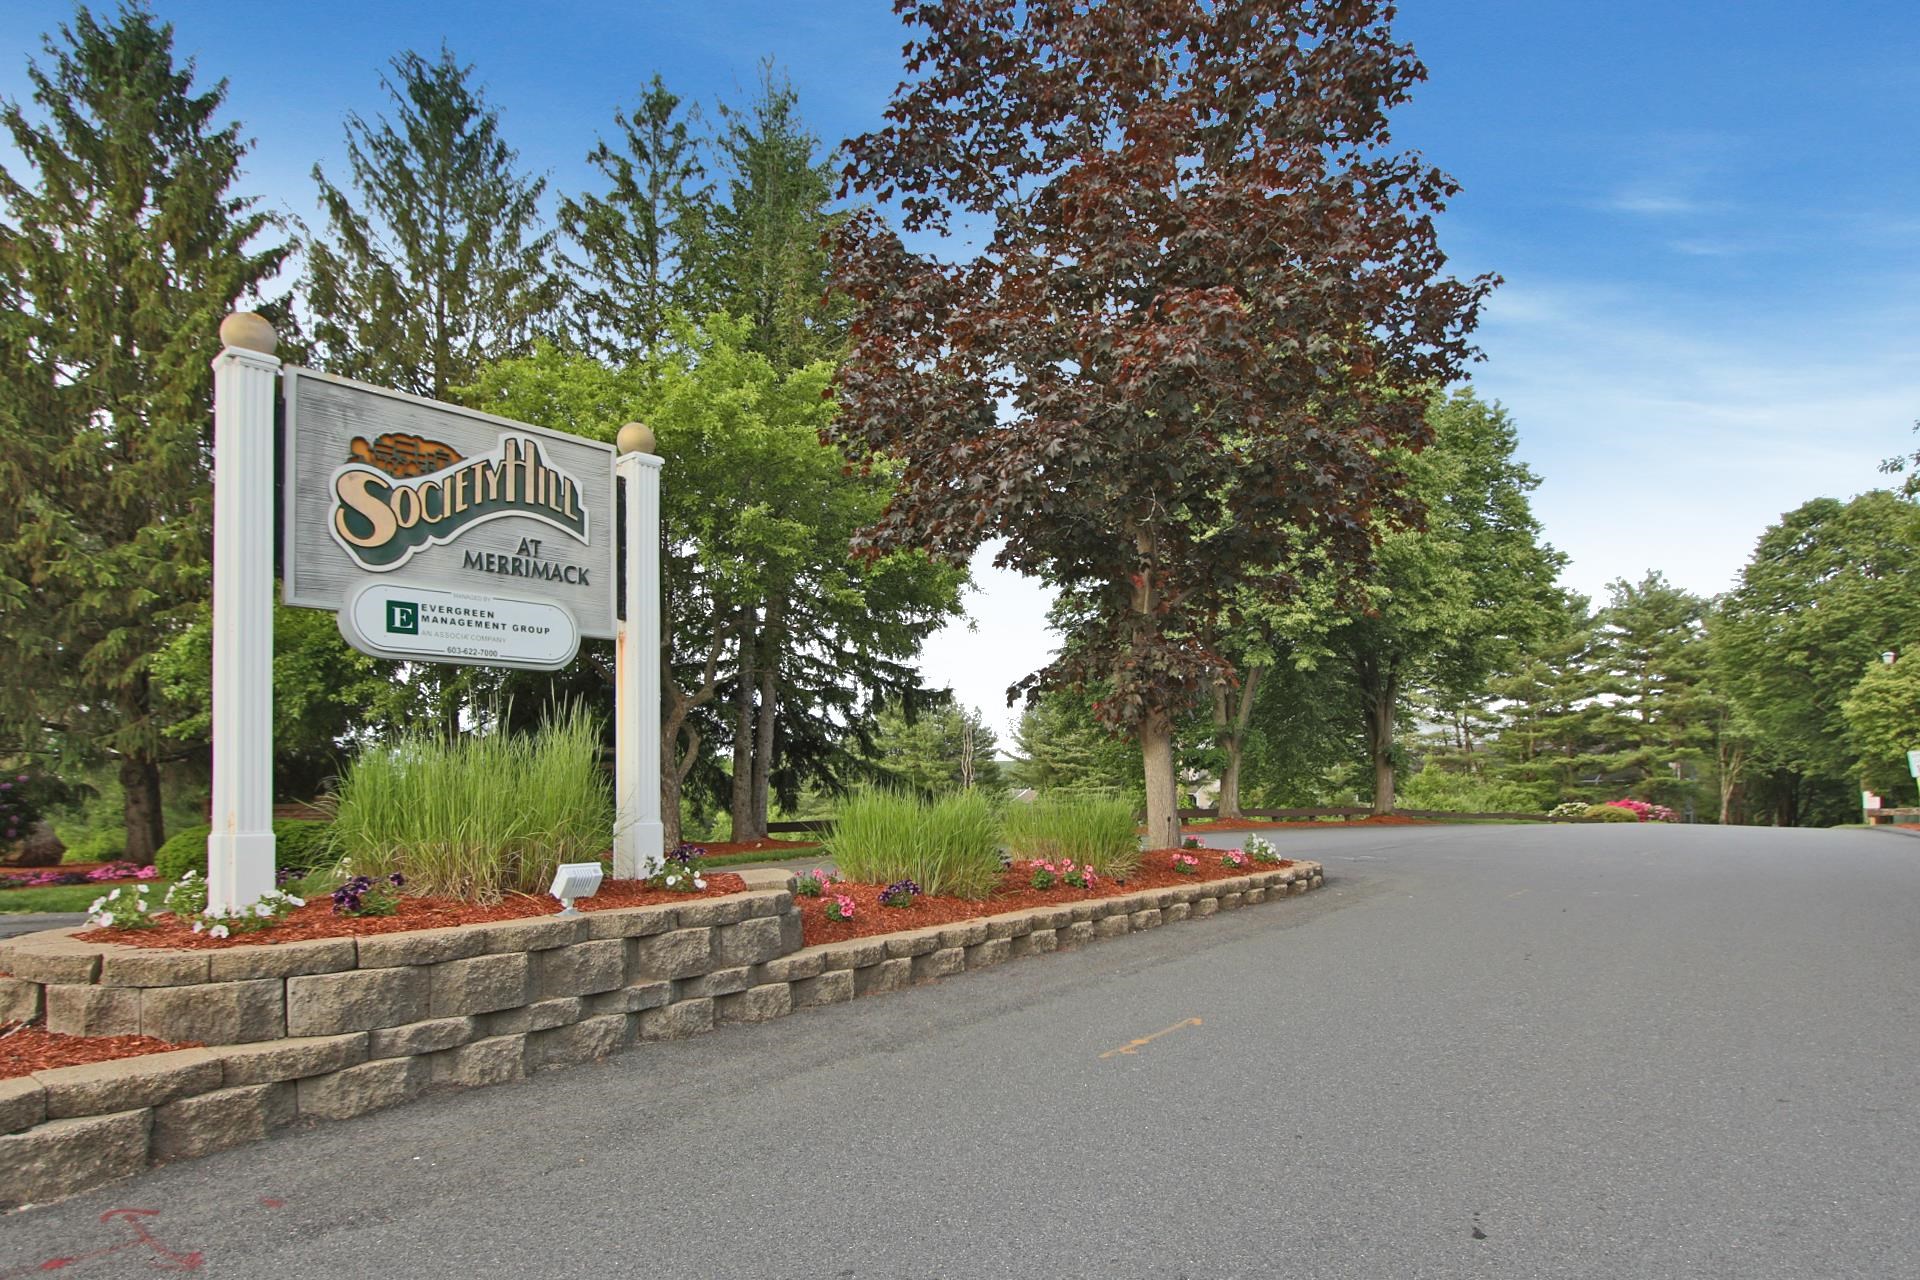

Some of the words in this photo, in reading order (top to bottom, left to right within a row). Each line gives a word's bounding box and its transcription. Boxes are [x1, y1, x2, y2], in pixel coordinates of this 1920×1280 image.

[515, 537, 542, 556] AT
[462, 549, 590, 586] MERRIMACK
[391, 606, 413, 629] E
[421, 603, 495, 619] EVERGREEN
[421, 615, 508, 631] MANAGEMENT
[512, 624, 551, 635] GROUP
[421, 630, 433, 638] AN
[469, 633, 507, 643] COMPANY
[446, 646, 498, 657] 603-622-7000
